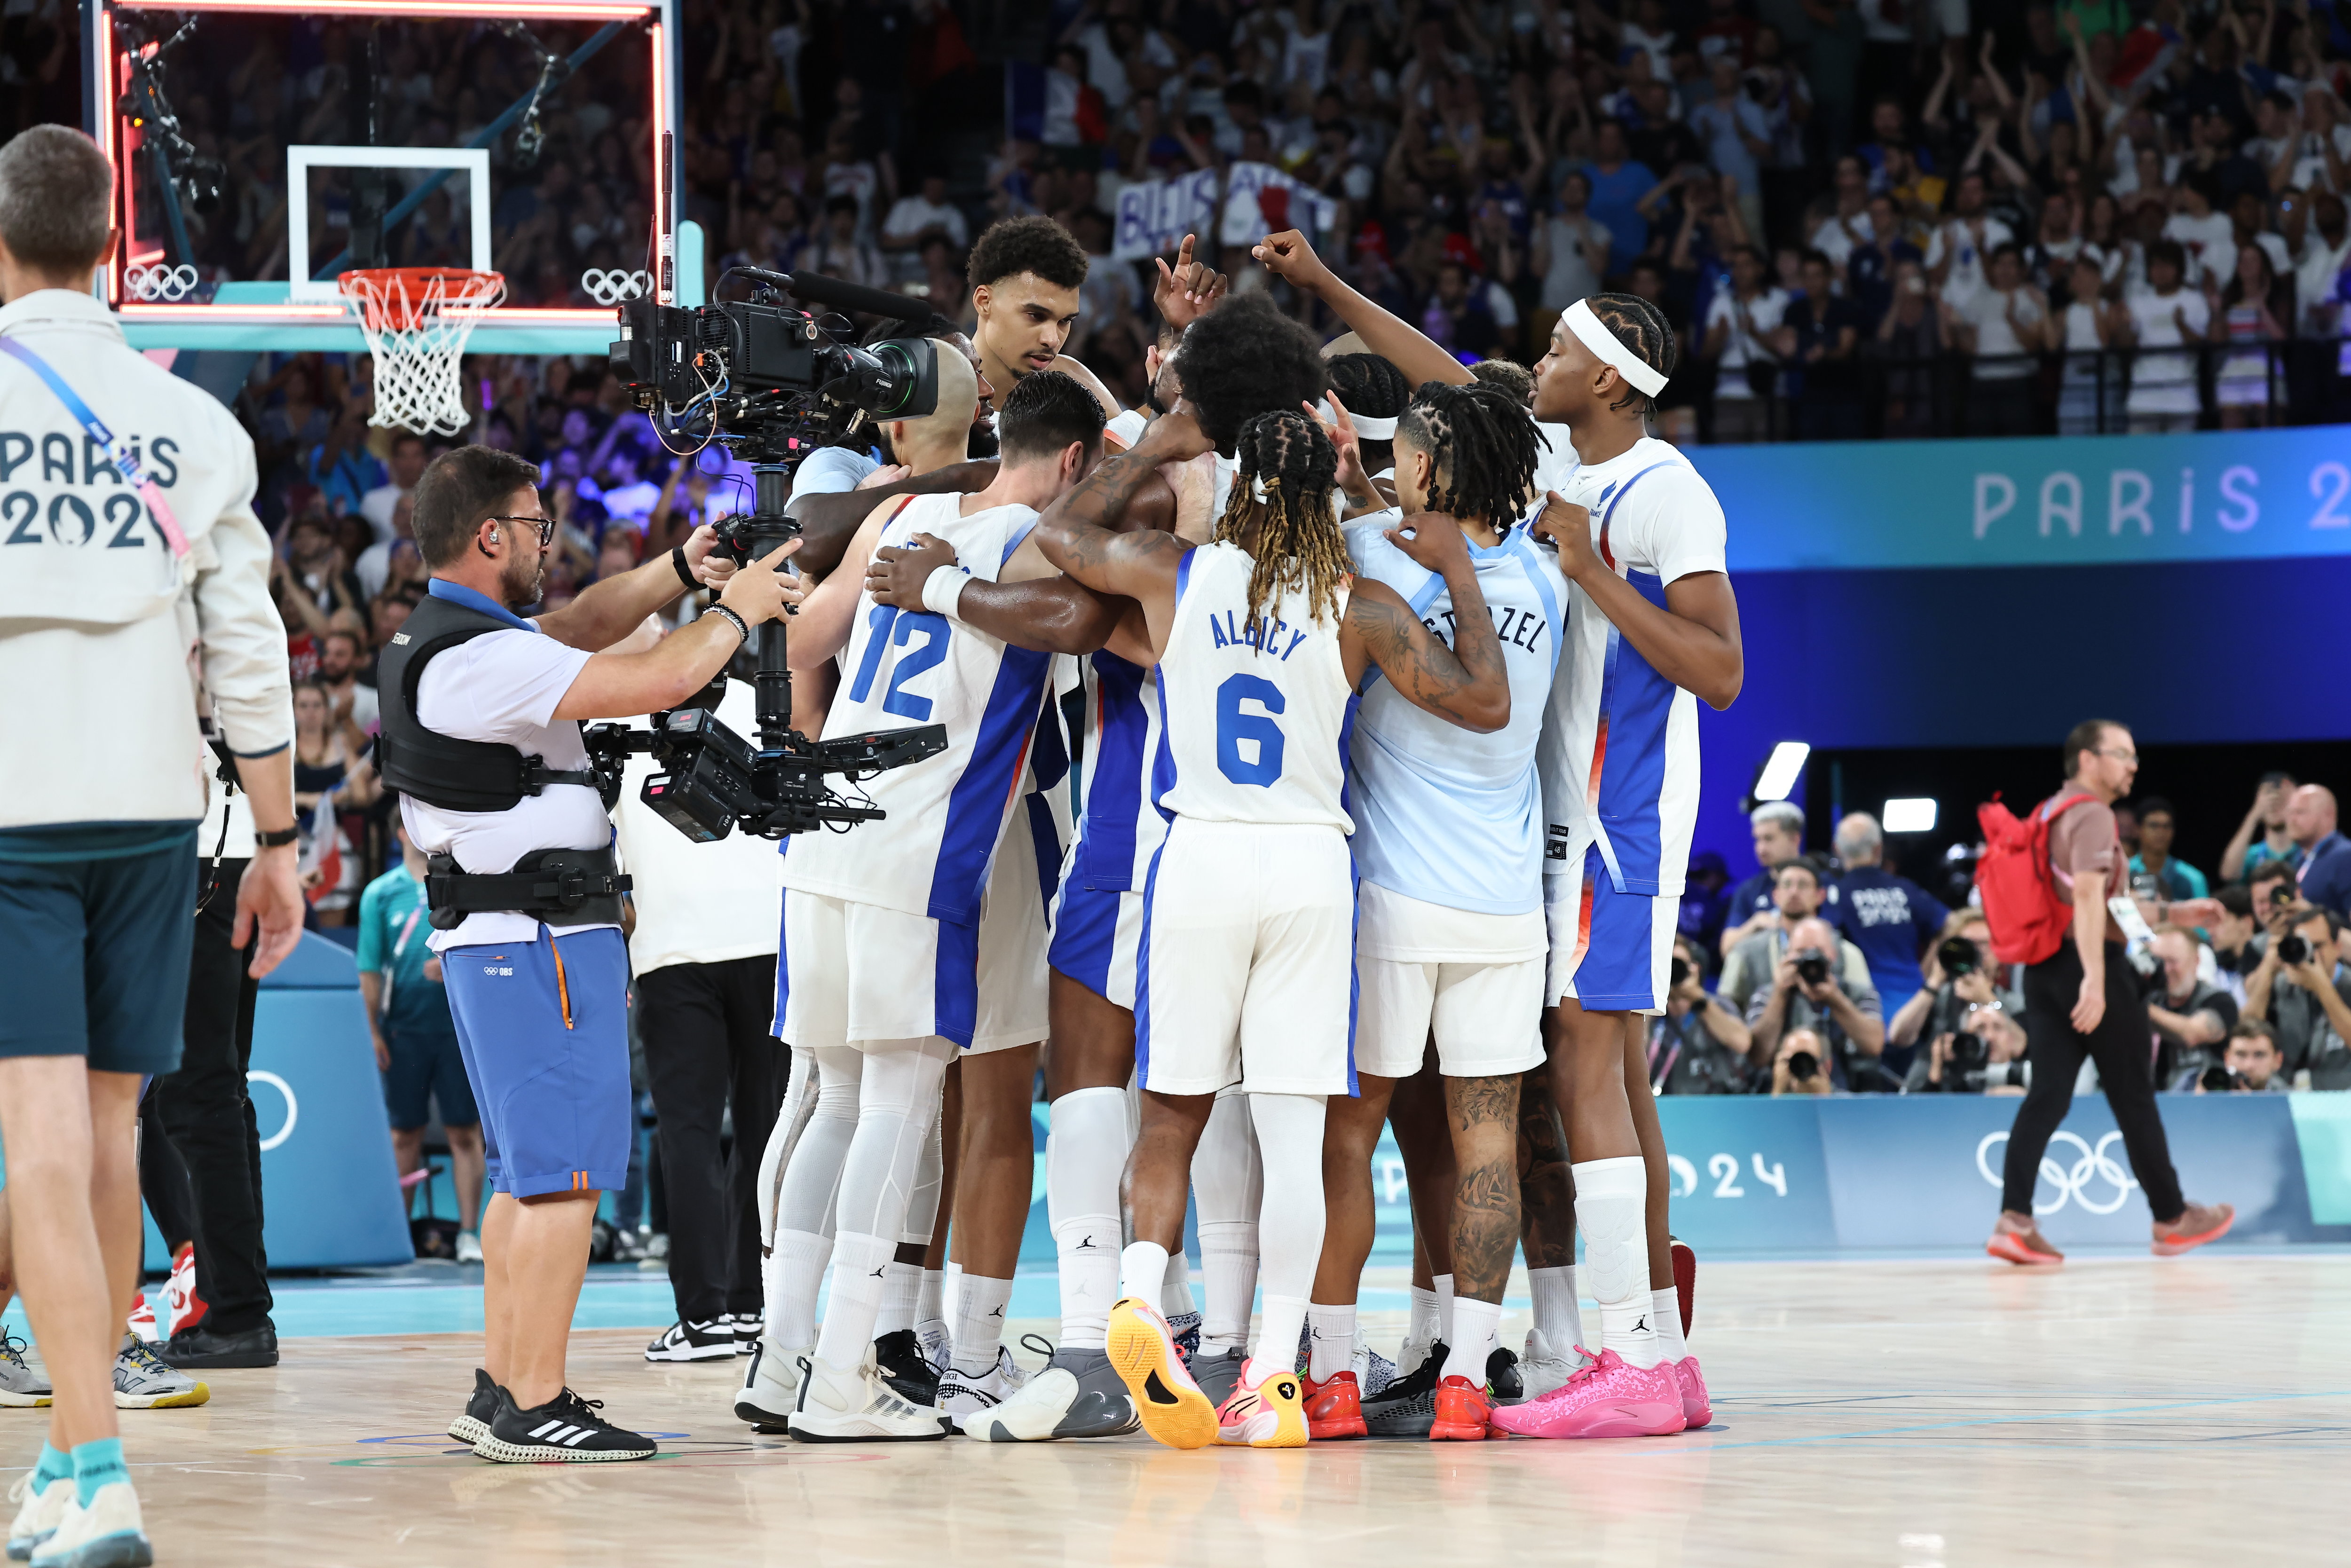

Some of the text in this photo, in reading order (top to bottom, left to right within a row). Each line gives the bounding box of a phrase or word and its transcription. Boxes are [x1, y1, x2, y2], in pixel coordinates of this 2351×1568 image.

[876, 378, 892, 388] FUJINON
[2, 491, 172, 552] 202
[1210, 610, 1307, 662] ALBICY
[1422, 607, 1546, 654] STZEL
[849, 604, 951, 721] 12
[1217, 673, 1285, 788] 6
[499, 967, 513, 976] OBS
[1667, 1153, 1788, 1199] 024
